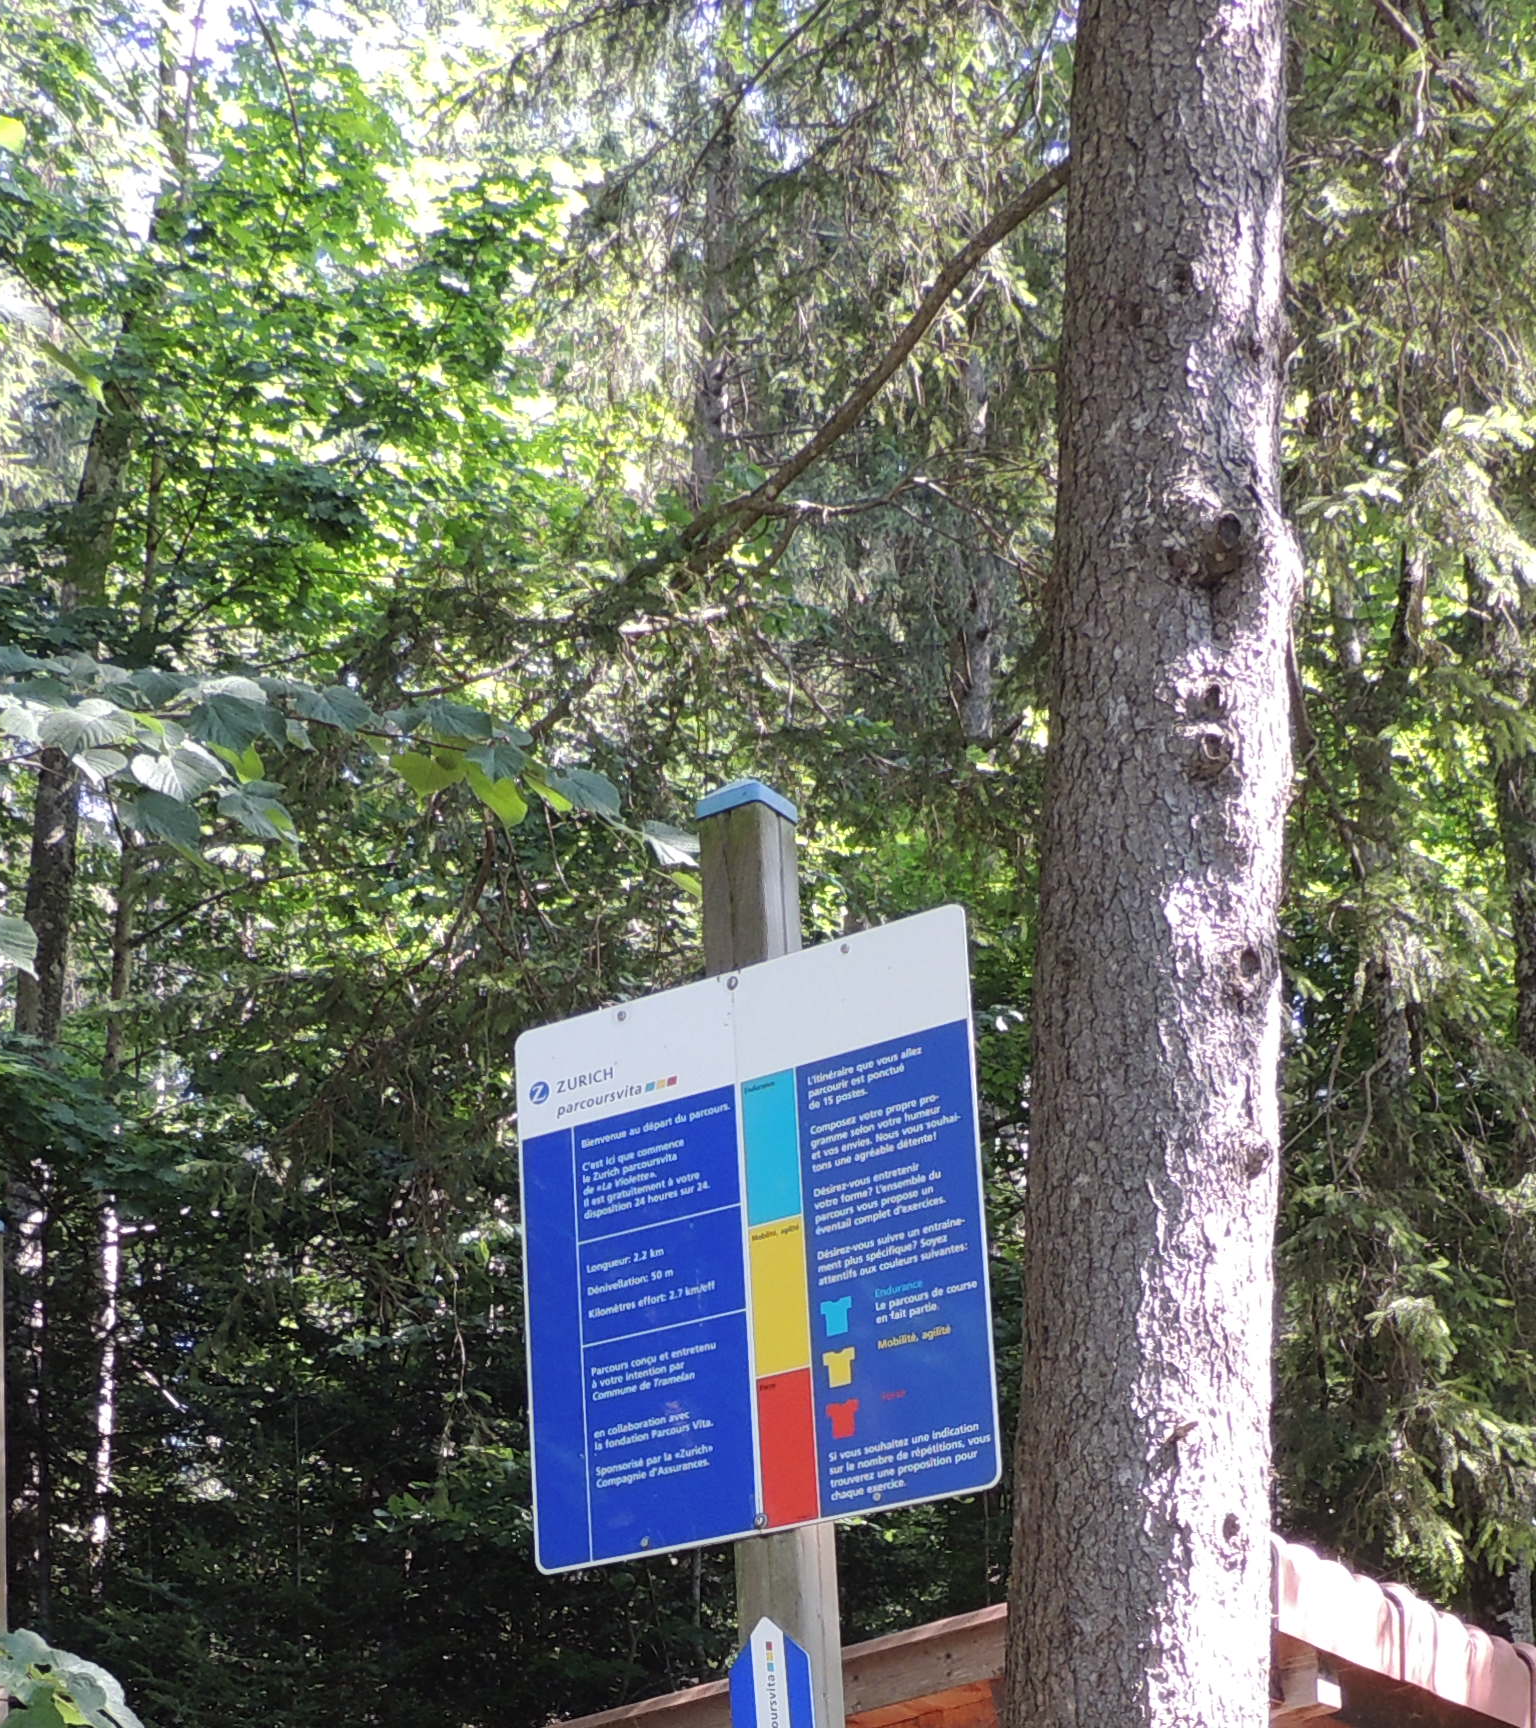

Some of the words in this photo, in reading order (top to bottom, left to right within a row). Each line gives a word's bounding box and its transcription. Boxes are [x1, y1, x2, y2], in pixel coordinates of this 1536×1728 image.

[557, 1067, 613, 1093] ZURICH
[807, 1065, 854, 1086] L'itinéraire
[856, 1061, 874, 1073] que
[876, 1054, 898, 1066] vous
[900, 1046, 923, 1060] allez
[808, 1080, 848, 1100] parcourir
[851, 1074, 865, 1086] est
[867, 1062, 905, 1083] ponctué
[557, 1085, 642, 1118] parcoursvita
[809, 1100, 820, 1110] de
[823, 1096, 833, 1106] 15
[836, 1088, 868, 1104] postes.
[810, 1115, 857, 1135] Composez
[859, 1108, 883, 1122] votre
[885, 1099, 916, 1117] propre
[919, 1094, 940, 1107] pro-
[581, 1130, 627, 1148] Bienvenue
[629, 1126, 641, 1136] au
[643, 1119, 673, 1136] départ
[675, 1112, 687, 1124] du
[689, 1103, 731, 1122] parcours.
[810, 1132, 848, 1150] gramme
[850, 1123, 875, 1138] selon
[877, 1117, 902, 1130] votre
[904, 1105, 941, 1122] humeur
[811, 1150, 821, 1160] et
[824, 1146, 839, 1157] vos
[841, 1137, 873, 1152] envies.
[875, 1130, 900, 1143] Nous
[902, 1123, 924, 1136] vous
[926, 1112, 961, 1129] souhai-
[582, 1158, 603, 1172] C'est
[606, 1156, 615, 1166] ici
[618, 1152, 635, 1165] que
[637, 1138, 684, 1157] commence
[583, 1174, 591, 1183] le
[593, 1168, 620, 1181] Zurich
[622, 1153, 677, 1175] parcoursvita
[812, 1161, 832, 1173] tons
[835, 1155, 852, 1167] une
[854, 1142, 895, 1162] agréable
[897, 1132, 937, 1150] détente!
[583, 1185, 594, 1195] de
[584, 1199, 590, 1208] Il
[591, 1196, 605, 1206] est
[607, 1182, 665, 1205] gratuitement
[668, 1177, 674, 1187] à
[676, 1172, 700, 1184] votre
[813, 1176, 871, 1197] Désirez-vous
[873, 1162, 920, 1183] entretenir
[814, 1197, 838, 1210] votre
[841, 1187, 872, 1203] forme?
[876, 1174, 926, 1194] L'ensemble
[929, 1169, 942, 1180] du
[584, 1202, 632, 1219] disposition
[634, 1197, 646, 1207] 24
[648, 1189, 678, 1204] heures
[680, 1187, 694, 1196] sur
[696, 1181, 710, 1192] 24.
[815, 1206, 854, 1224] parcours
[857, 1199, 879, 1212] vous
[881, 1190, 919, 1208] propose
[921, 1186, 934, 1196] un
[815, 1217, 852, 1235] éventail
[854, 1209, 892, 1227] complet
[893, 1196, 947, 1216] d'exercices.
[586, 1256, 631, 1273] Longueur:
[633, 1252, 647, 1262] 2.2
[649, 1248, 664, 1258] km
[817, 1238, 875, 1260] Désirez-vous
[877, 1231, 905, 1246] suivre
[907, 1228, 920, 1238] un
[818, 1260, 842, 1273] ment
[844, 1254, 864, 1268] plus
[865, 1240, 917, 1262] spécifique?
[920, 1234, 948, 1250] Soyez
[818, 1268, 857, 1286] attentifs
[860, 1265, 877, 1276] aux
[879, 1254, 918, 1271] couleurs
[920, 1242, 968, 1262] suivantes:
[587, 1275, 649, 1296] Dénivellation:
[651, 1270, 663, 1281] 50
[665, 1269, 674, 1278] m
[588, 1301, 636, 1318] Kilomètres
[638, 1293, 667, 1308] effort:
[669, 1289, 683, 1300] 2.7
[685, 1280, 715, 1296] km/eff
[874, 1280, 924, 1298] Endurance
[875, 1301, 886, 1311] Le
[888, 1292, 929, 1309] parcours
[931, 1286, 944, 1297] de
[946, 1280, 978, 1294] course
[875, 1314, 888, 1324] en
[890, 1309, 906, 1320] fait
[877, 1332, 919, 1350] Mobilité,
[922, 1324, 952, 1340] agilité
[591, 1361, 629, 1376] Parcours
[631, 1355, 657, 1368] conçu
[659, 1353, 669, 1361] et
[671, 1342, 716, 1358] entretenu
[592, 1380, 597, 1389] à
[599, 1375, 623, 1387] votre
[625, 1366, 667, 1382] intention
[669, 1361, 684, 1373] par
[592, 1384, 637, 1401] Commune
[639, 1381, 651, 1391] de
[653, 1371, 695, 1388] Tramelan
[594, 1429, 605, 1439] en
[607, 1416, 666, 1436] collaboration
[668, 1411, 690, 1423] avec
[595, 1440, 603, 1450] la
[605, 1432, 649, 1449] fondation
[651, 1423, 690, 1438] Parcours
[692, 1418, 714, 1430] Vita.
[828, 1451, 838, 1462] Si
[840, 1447, 862, 1459] vous
[864, 1437, 909, 1454] souhaitez
[911, 1433, 930, 1444] une
[932, 1423, 979, 1440] indication
[829, 1465, 844, 1475] sur
[846, 1461, 855, 1471] le
[857, 1454, 894, 1469] nombre
[896, 1450, 909, 1461] de
[911, 1441, 965, 1459] répétitions,
[967, 1434, 991, 1446] vous
[596, 1458, 644, 1477] Sponsorisé
[646, 1454, 662, 1467] par
[664, 1452, 672, 1460] la
[596, 1470, 646, 1488] Compagnie
[649, 1458, 710, 1477] d'Assurances.
[830, 1472, 874, 1488] trouverez
[877, 1467, 895, 1478] une
[897, 1455, 952, 1476] proposition
[954, 1449, 978, 1464] pour
[830, 1485, 864, 1501] chaque
[866, 1478, 906, 1494] exercice.
